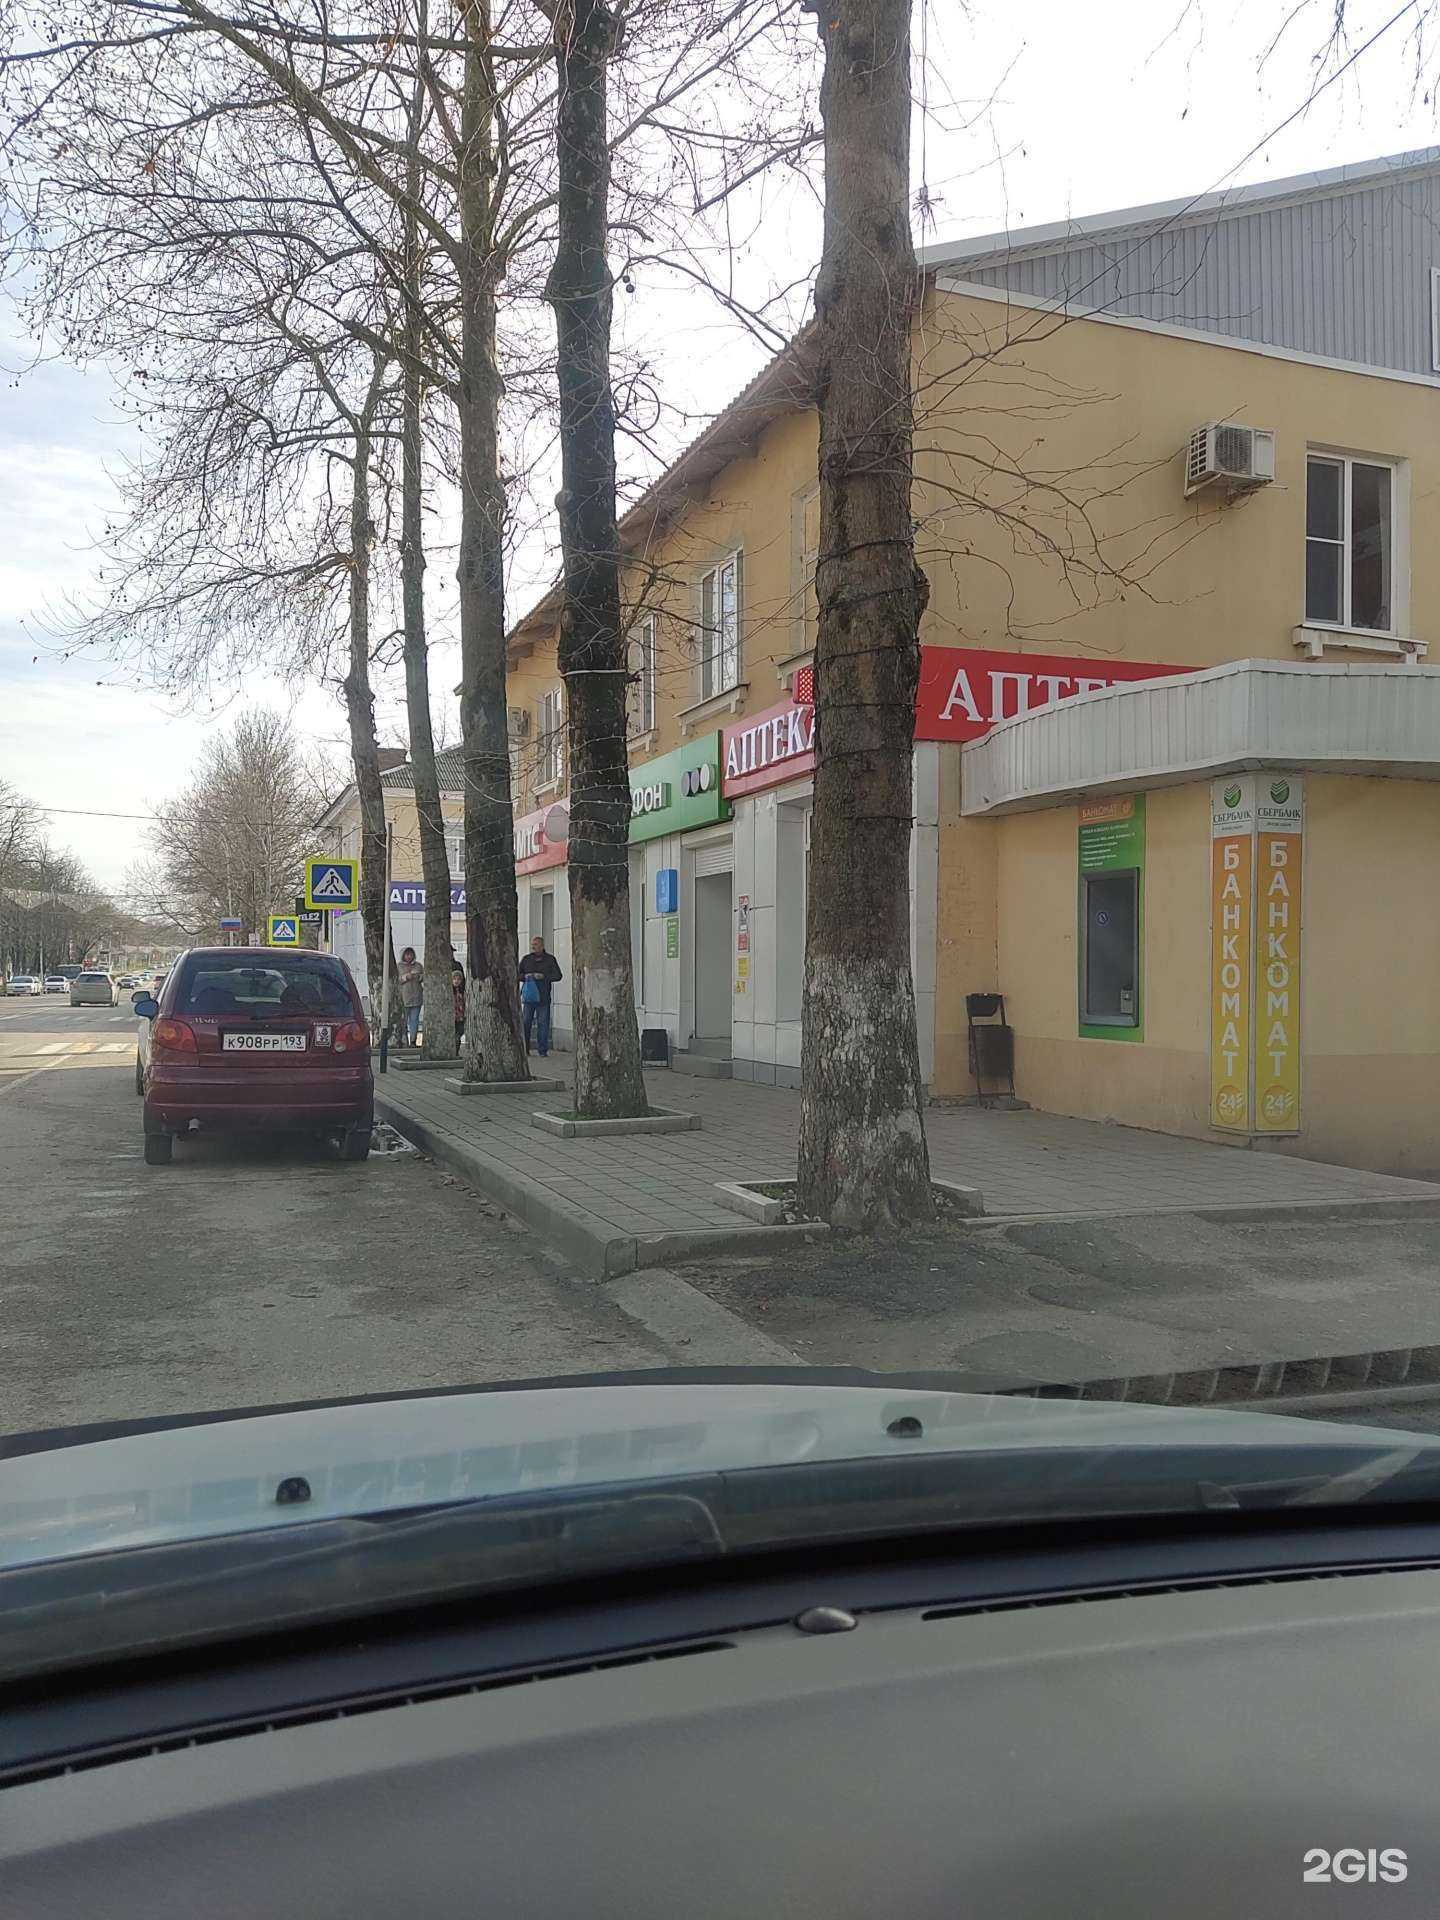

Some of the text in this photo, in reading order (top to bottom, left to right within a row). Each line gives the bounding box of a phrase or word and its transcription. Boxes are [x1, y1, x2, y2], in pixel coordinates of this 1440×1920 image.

[938, 669, 1133, 723] АПТ
[1213, 810, 1252, 823] СБЕРБАНК
[1257, 807, 1302, 819] СБЕРБАНК
[1221, 843, 1241, 1077] БАНКОМАТ
[1267, 841, 1290, 1077] БАНКОМАТ
[282, 1036, 302, 1047] 193
